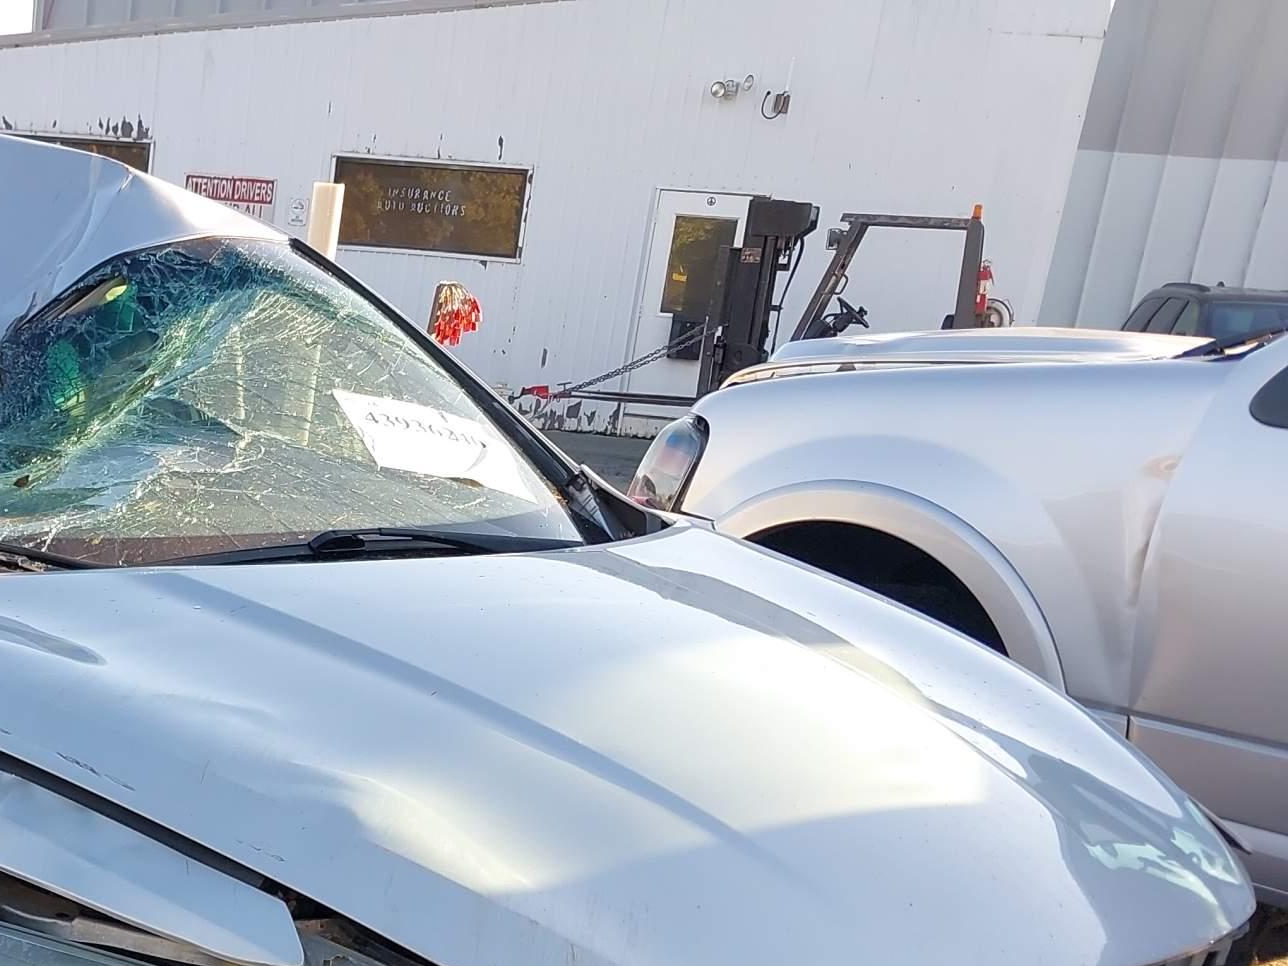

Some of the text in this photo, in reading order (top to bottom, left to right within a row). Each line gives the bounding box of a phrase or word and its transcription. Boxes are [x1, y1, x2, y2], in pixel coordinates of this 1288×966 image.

[187, 177, 273, 203] ATTENTION DRIVERS
[388, 187, 452, 202] INSURANCE
